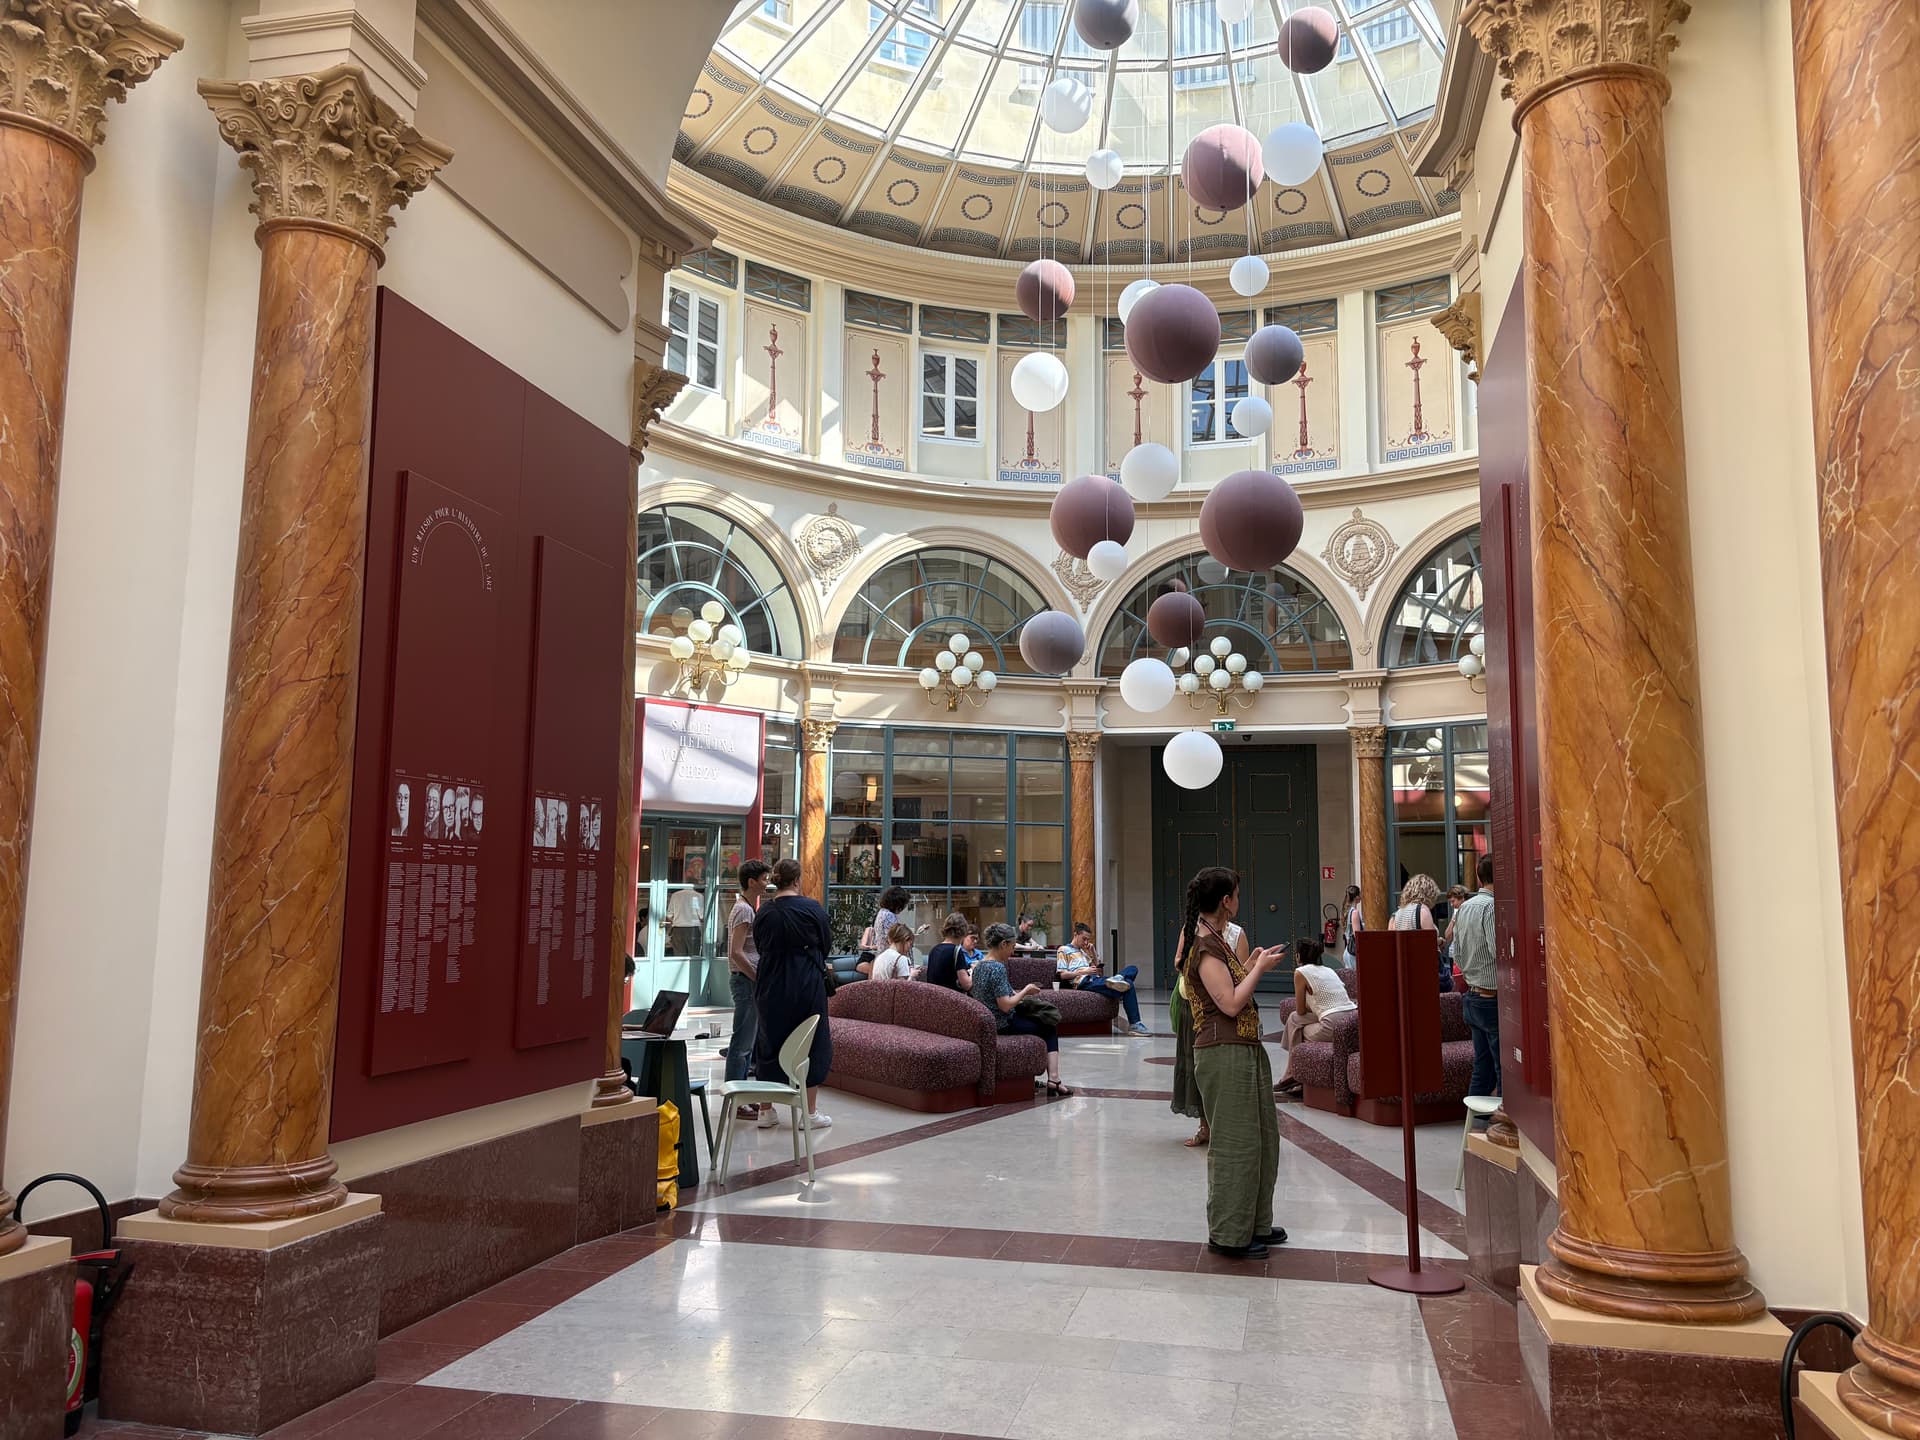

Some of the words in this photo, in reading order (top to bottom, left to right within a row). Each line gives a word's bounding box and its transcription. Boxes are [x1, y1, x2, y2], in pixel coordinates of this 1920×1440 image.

[434, 507, 450, 519] POUR
[415, 514, 434, 543] MAISON
[411, 545, 420, 564] UNE
[671, 719, 713, 736] SALLE
[661, 746, 688, 762] VON
